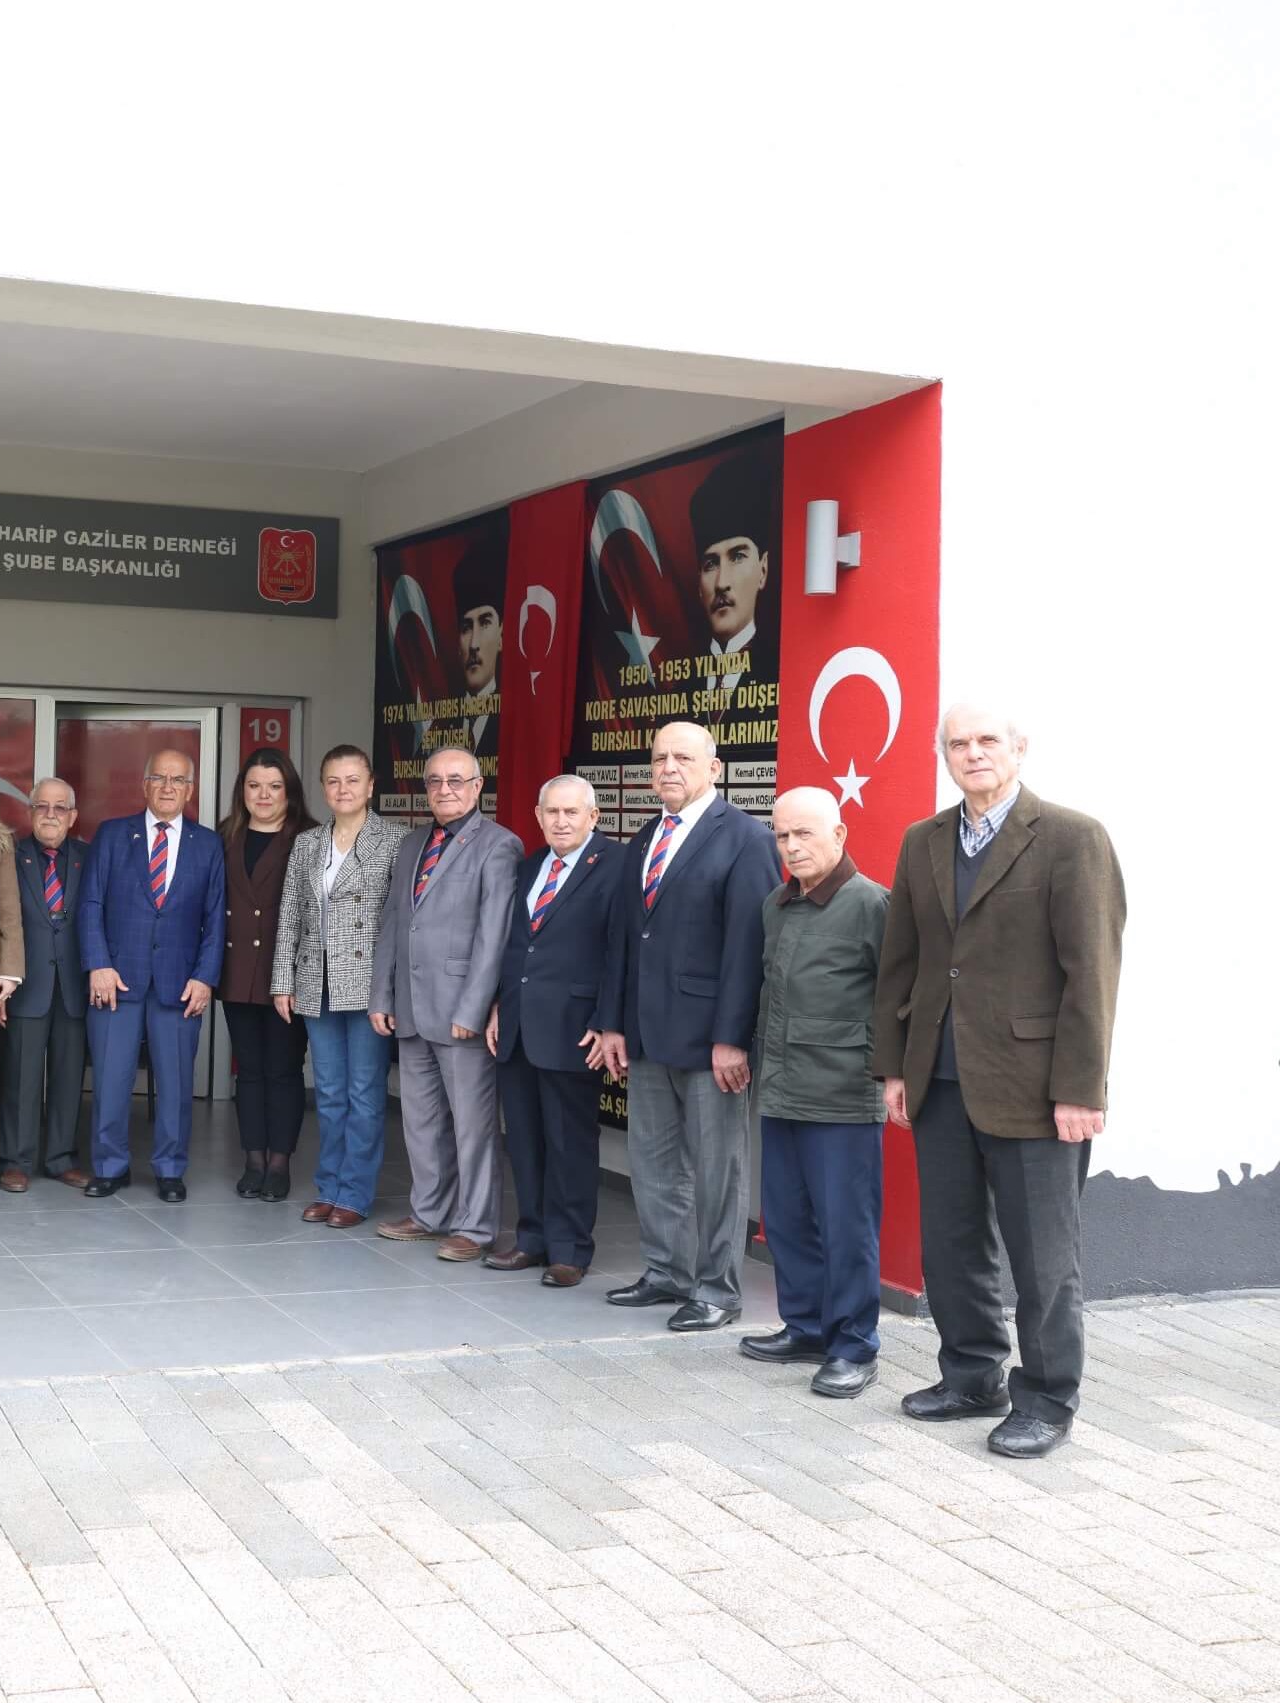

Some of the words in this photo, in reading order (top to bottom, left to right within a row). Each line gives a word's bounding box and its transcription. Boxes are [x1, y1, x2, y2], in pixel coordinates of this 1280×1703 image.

[63, 529, 147, 550] GAZİLER
[153, 536, 237, 556] DERNEĞİ
[2, 552, 56, 572] ŞUBE
[62, 556, 180, 578] BAŞKANLIĞI
[619, 666, 648, 687] 1950
[658, 658, 691, 682] 1953
[695, 650, 751, 678] YILINDA
[383, 704, 404, 725] 1974
[406, 701, 433, 721] YILINDA
[434, 699, 459, 719] KIBRIS
[585, 699, 616, 722] KORE
[619, 692, 689, 722] SAVAŞINDA
[692, 687, 734, 718] ŞEHİT
[737, 680, 779, 713] DÜŞE
[248, 718, 282, 742] 19
[591, 729, 641, 751] BURSALI
[596, 769, 617, 781] YAVUZ
[598, 793, 617, 803] TARIM
[731, 794, 755, 807] Hüseyin
[597, 816, 615, 828] RAKAŞ
